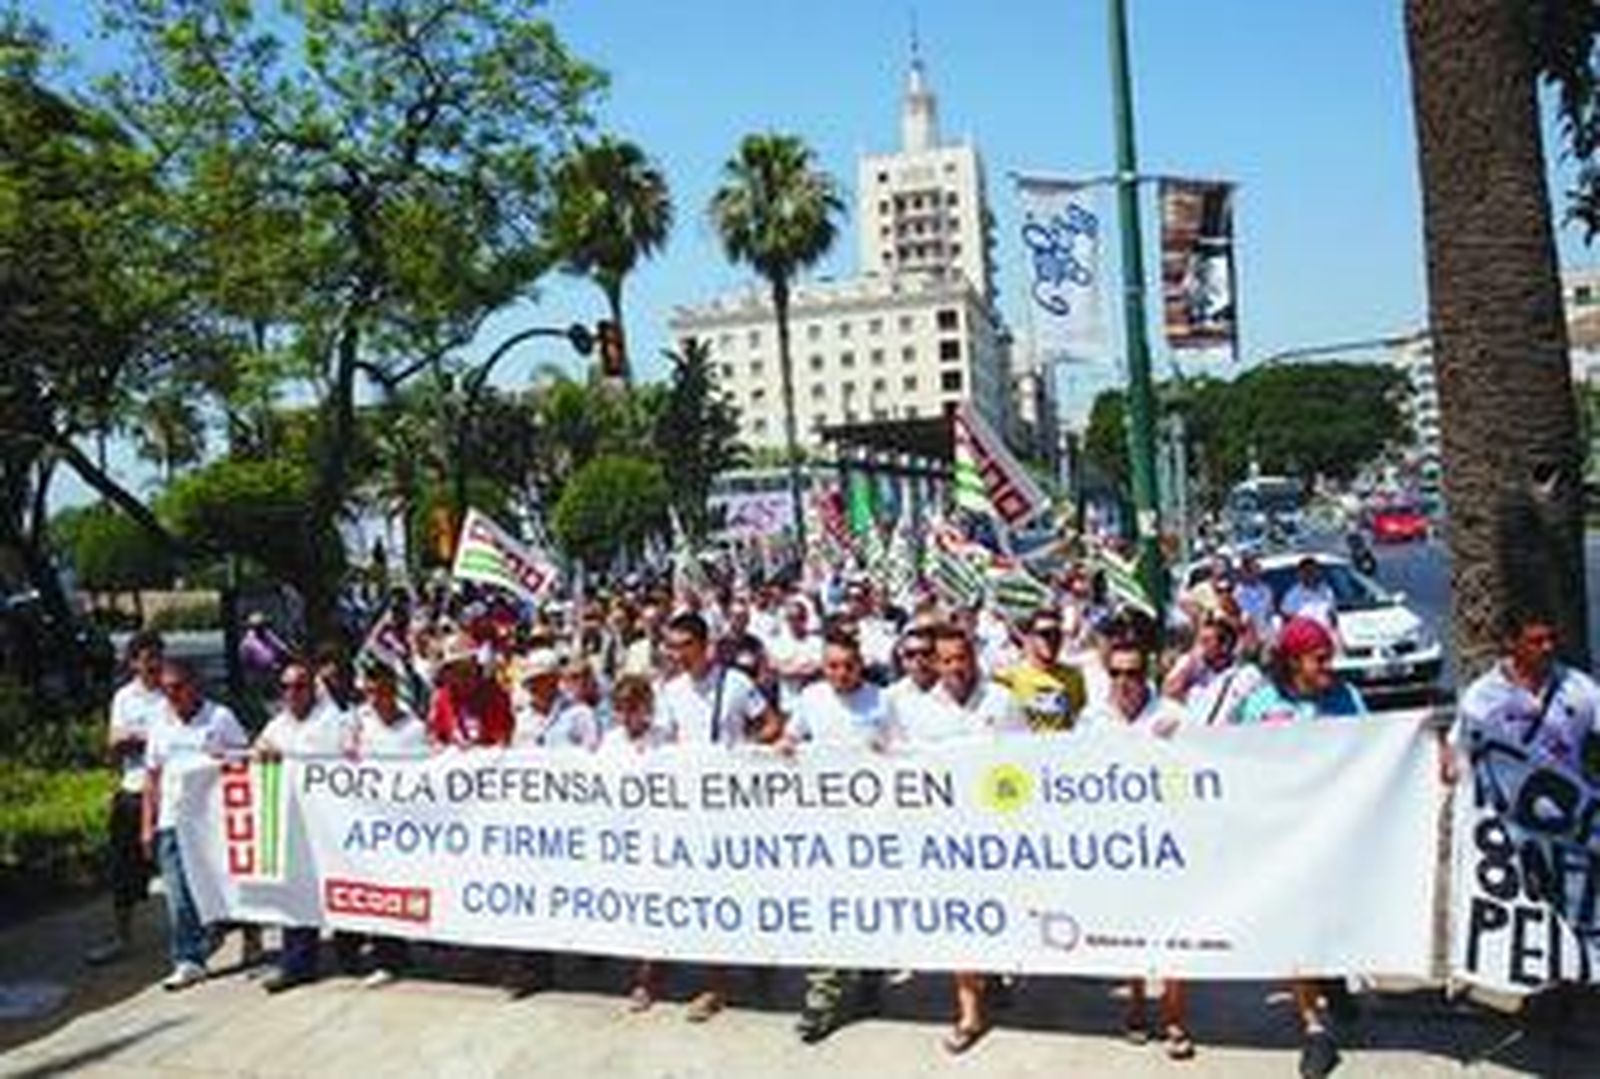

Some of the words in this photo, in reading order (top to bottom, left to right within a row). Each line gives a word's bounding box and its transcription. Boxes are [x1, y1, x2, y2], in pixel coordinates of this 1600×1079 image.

[304, 763, 383, 799] POR
[391, 771, 437, 802] LA
[446, 767, 613, 807] DEFENSA
[619, 773, 689, 809] DEL
[700, 769, 882, 809] EMPLEO
[895, 769, 955, 808] EN
[1041, 763, 1222, 803] isofotn
[343, 820, 470, 854] APOYO
[481, 825, 587, 861] FIRME
[600, 829, 642, 865] DE
[653, 832, 694, 869] LA
[705, 833, 834, 870] JUNTA
[848, 833, 904, 869] DE
[920, 823, 1186, 871] ANDALUCÍA
[462, 881, 537, 917] CON
[550, 885, 742, 932] PROYECTO
[758, 896, 813, 933] DE
[829, 897, 1006, 937] FUTURO
